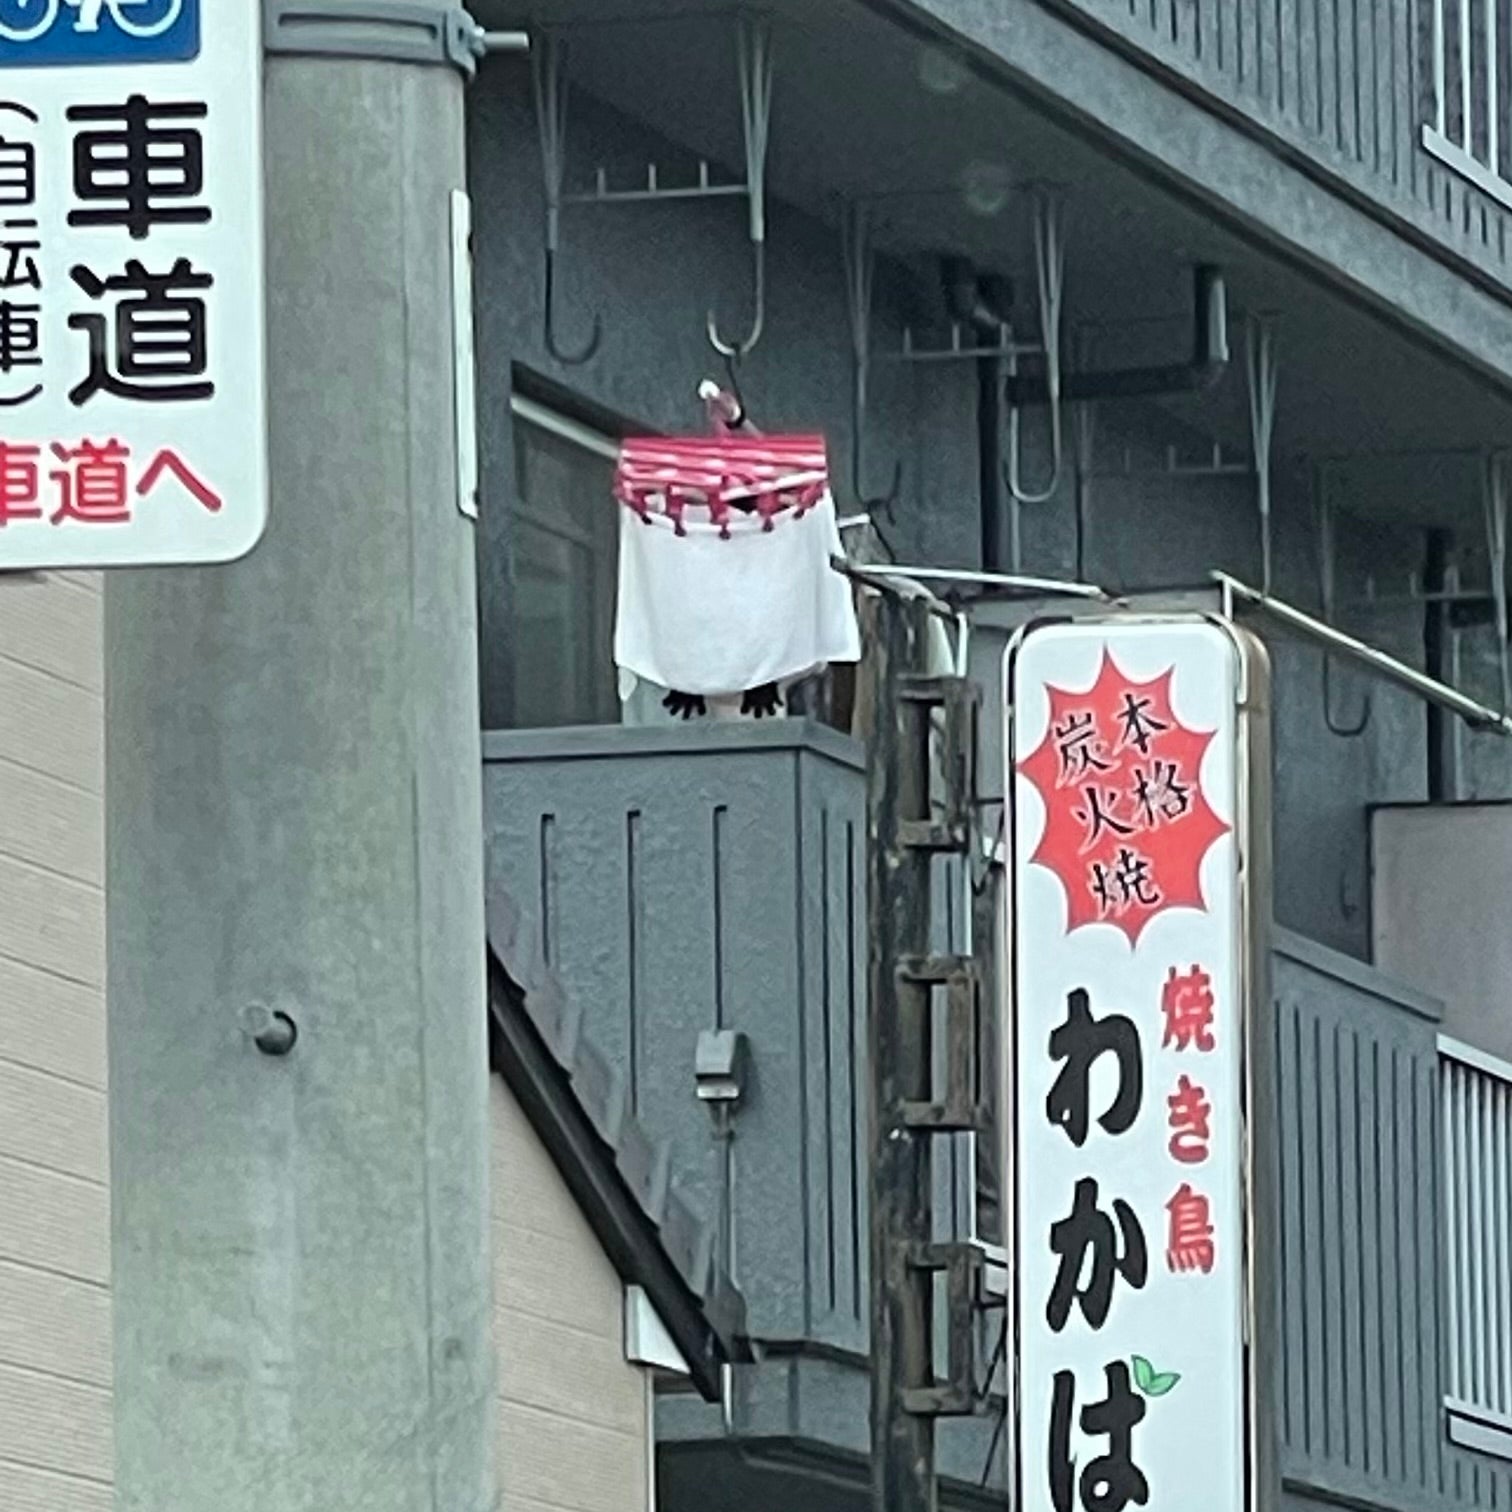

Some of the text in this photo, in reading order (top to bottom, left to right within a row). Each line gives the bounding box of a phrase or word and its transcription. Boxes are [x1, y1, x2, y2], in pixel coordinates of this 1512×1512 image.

[66, 94, 214, 407] 車道
[1055, 711, 1161, 915] 炭火焼
[1116, 692, 1190, 827] 本格
[1161, 964, 1215, 1274] 焼き鳥
